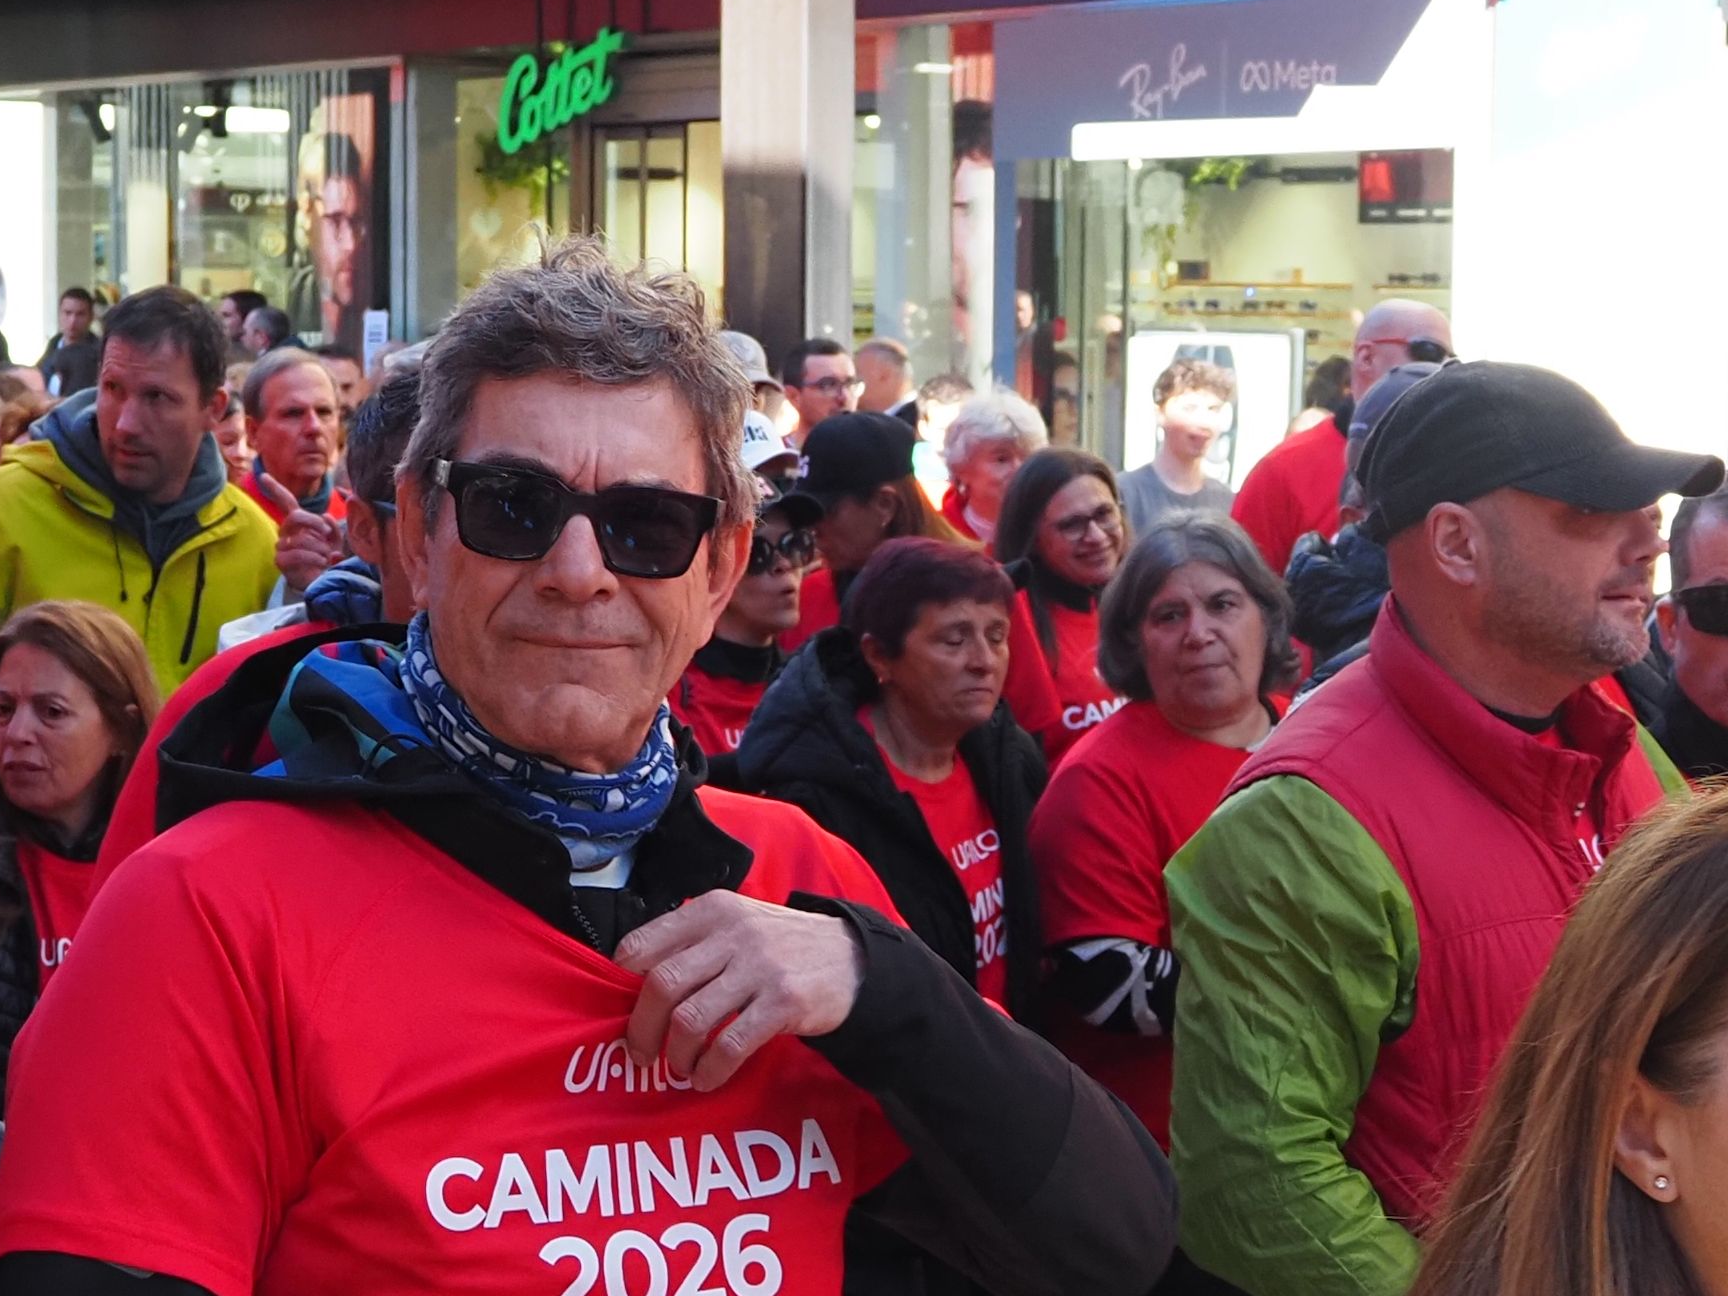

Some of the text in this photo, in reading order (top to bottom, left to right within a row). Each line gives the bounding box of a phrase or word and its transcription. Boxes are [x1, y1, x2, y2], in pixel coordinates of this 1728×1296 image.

[498, 26, 624, 155] Cottet
[1274, 60, 1337, 90] Meta
[425, 1119, 841, 1232] CAMINADA
